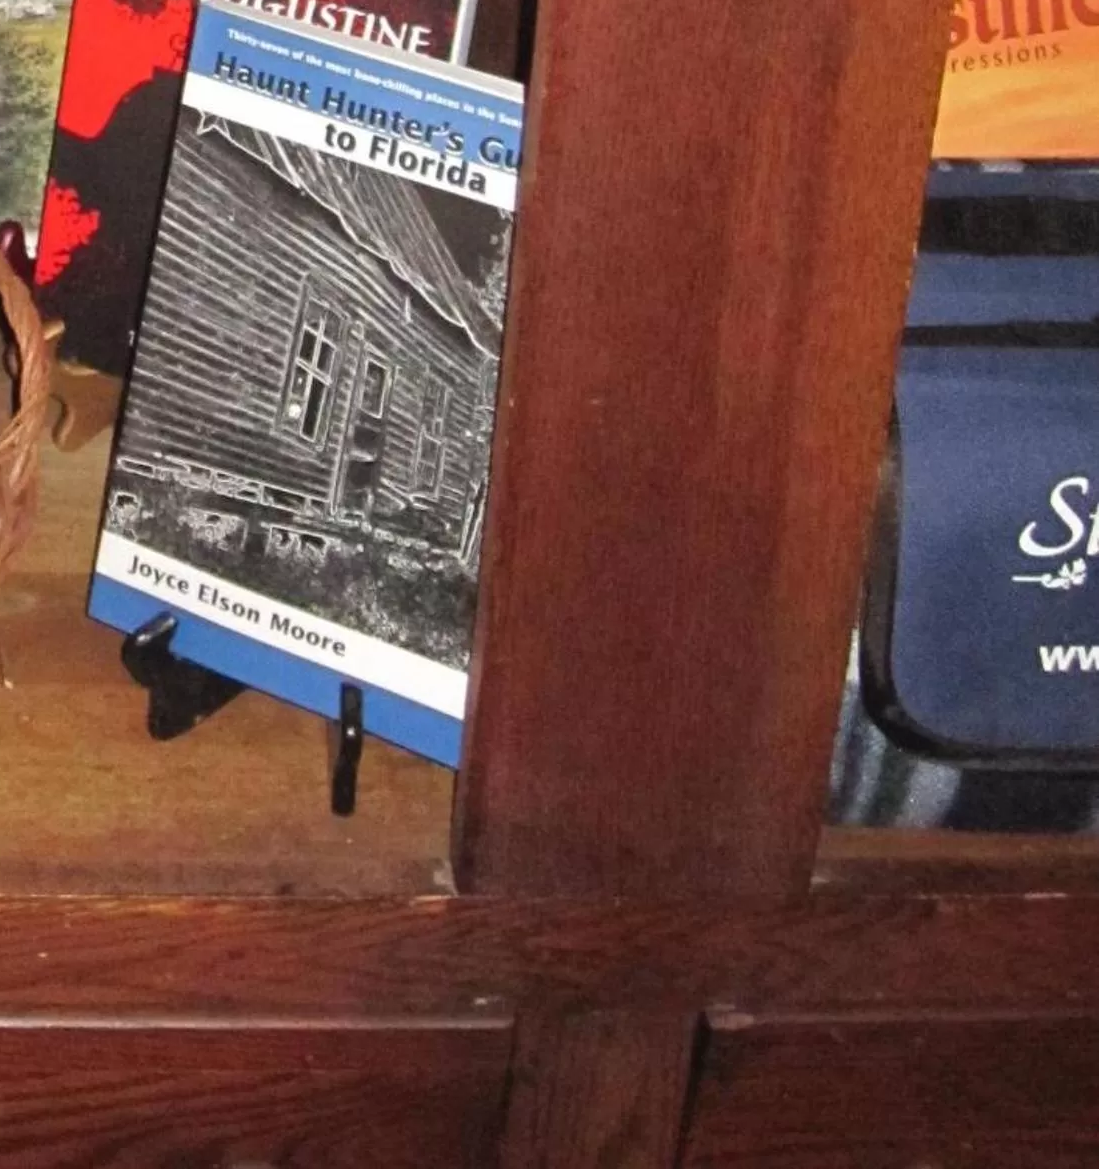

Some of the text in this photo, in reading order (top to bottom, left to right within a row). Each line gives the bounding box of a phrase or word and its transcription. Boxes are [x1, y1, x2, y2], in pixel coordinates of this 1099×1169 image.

[212, 52, 310, 108] Haunt
[321, 86, 465, 154] Hunter's
[227, 28, 290, 58] Thirty-seven
[292, 48, 305, 61] of
[305, 53, 323, 68] the
[325, 60, 351, 76] most
[425, 89, 459, 110] places
[477, 105, 495, 120] the
[325, 123, 487, 194] to Florida
[127, 556, 347, 657] Joyce Elson Moore
